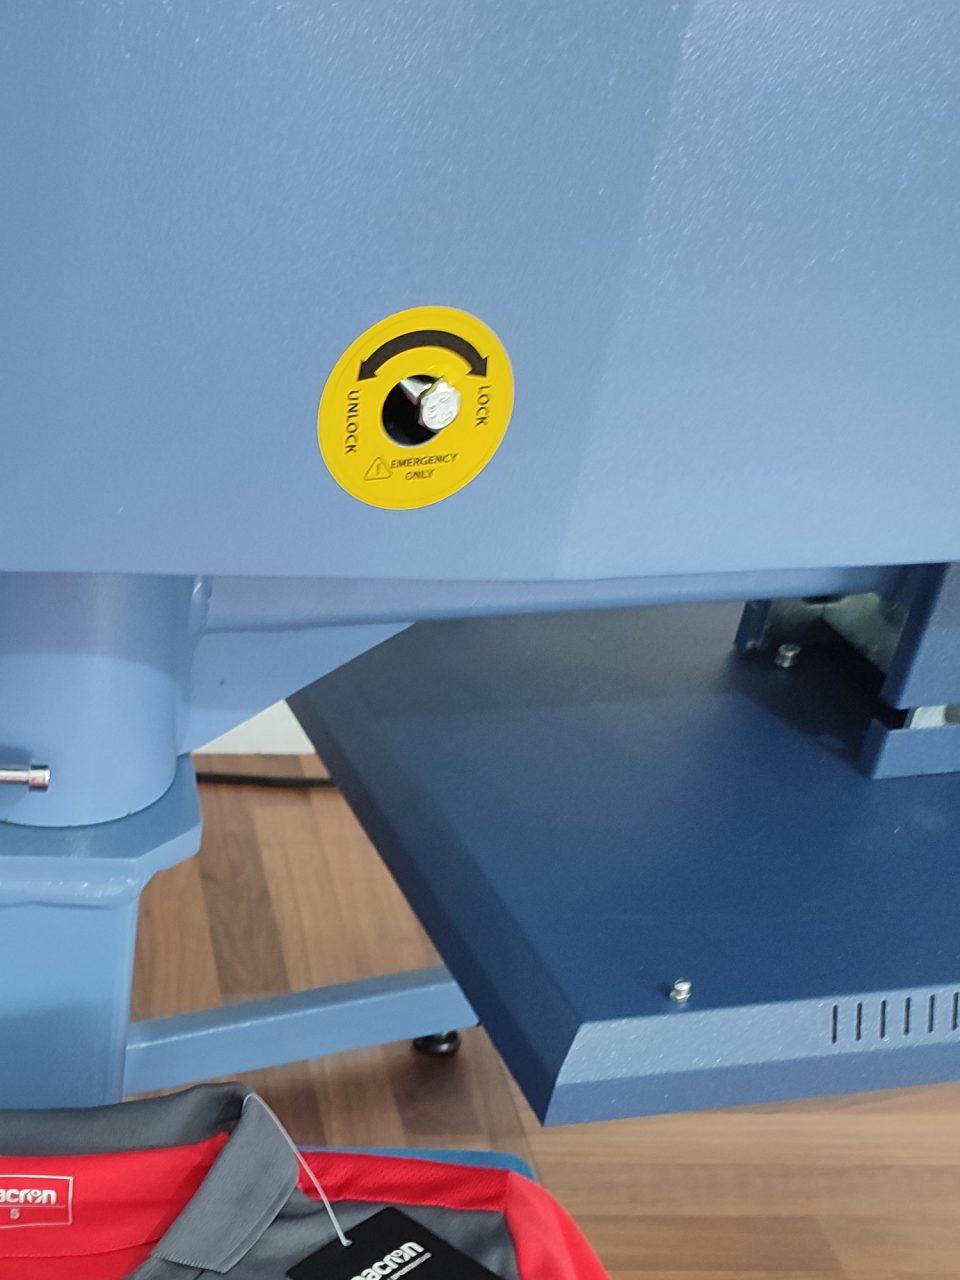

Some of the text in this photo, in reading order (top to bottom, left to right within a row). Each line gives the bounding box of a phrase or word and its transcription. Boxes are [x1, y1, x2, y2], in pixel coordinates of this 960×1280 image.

[476, 386, 491, 426] LOCK
[345, 390, 360, 454] UNLOCK
[391, 453, 459, 469] EMERGENCY
[405, 468, 436, 481] ONLY
